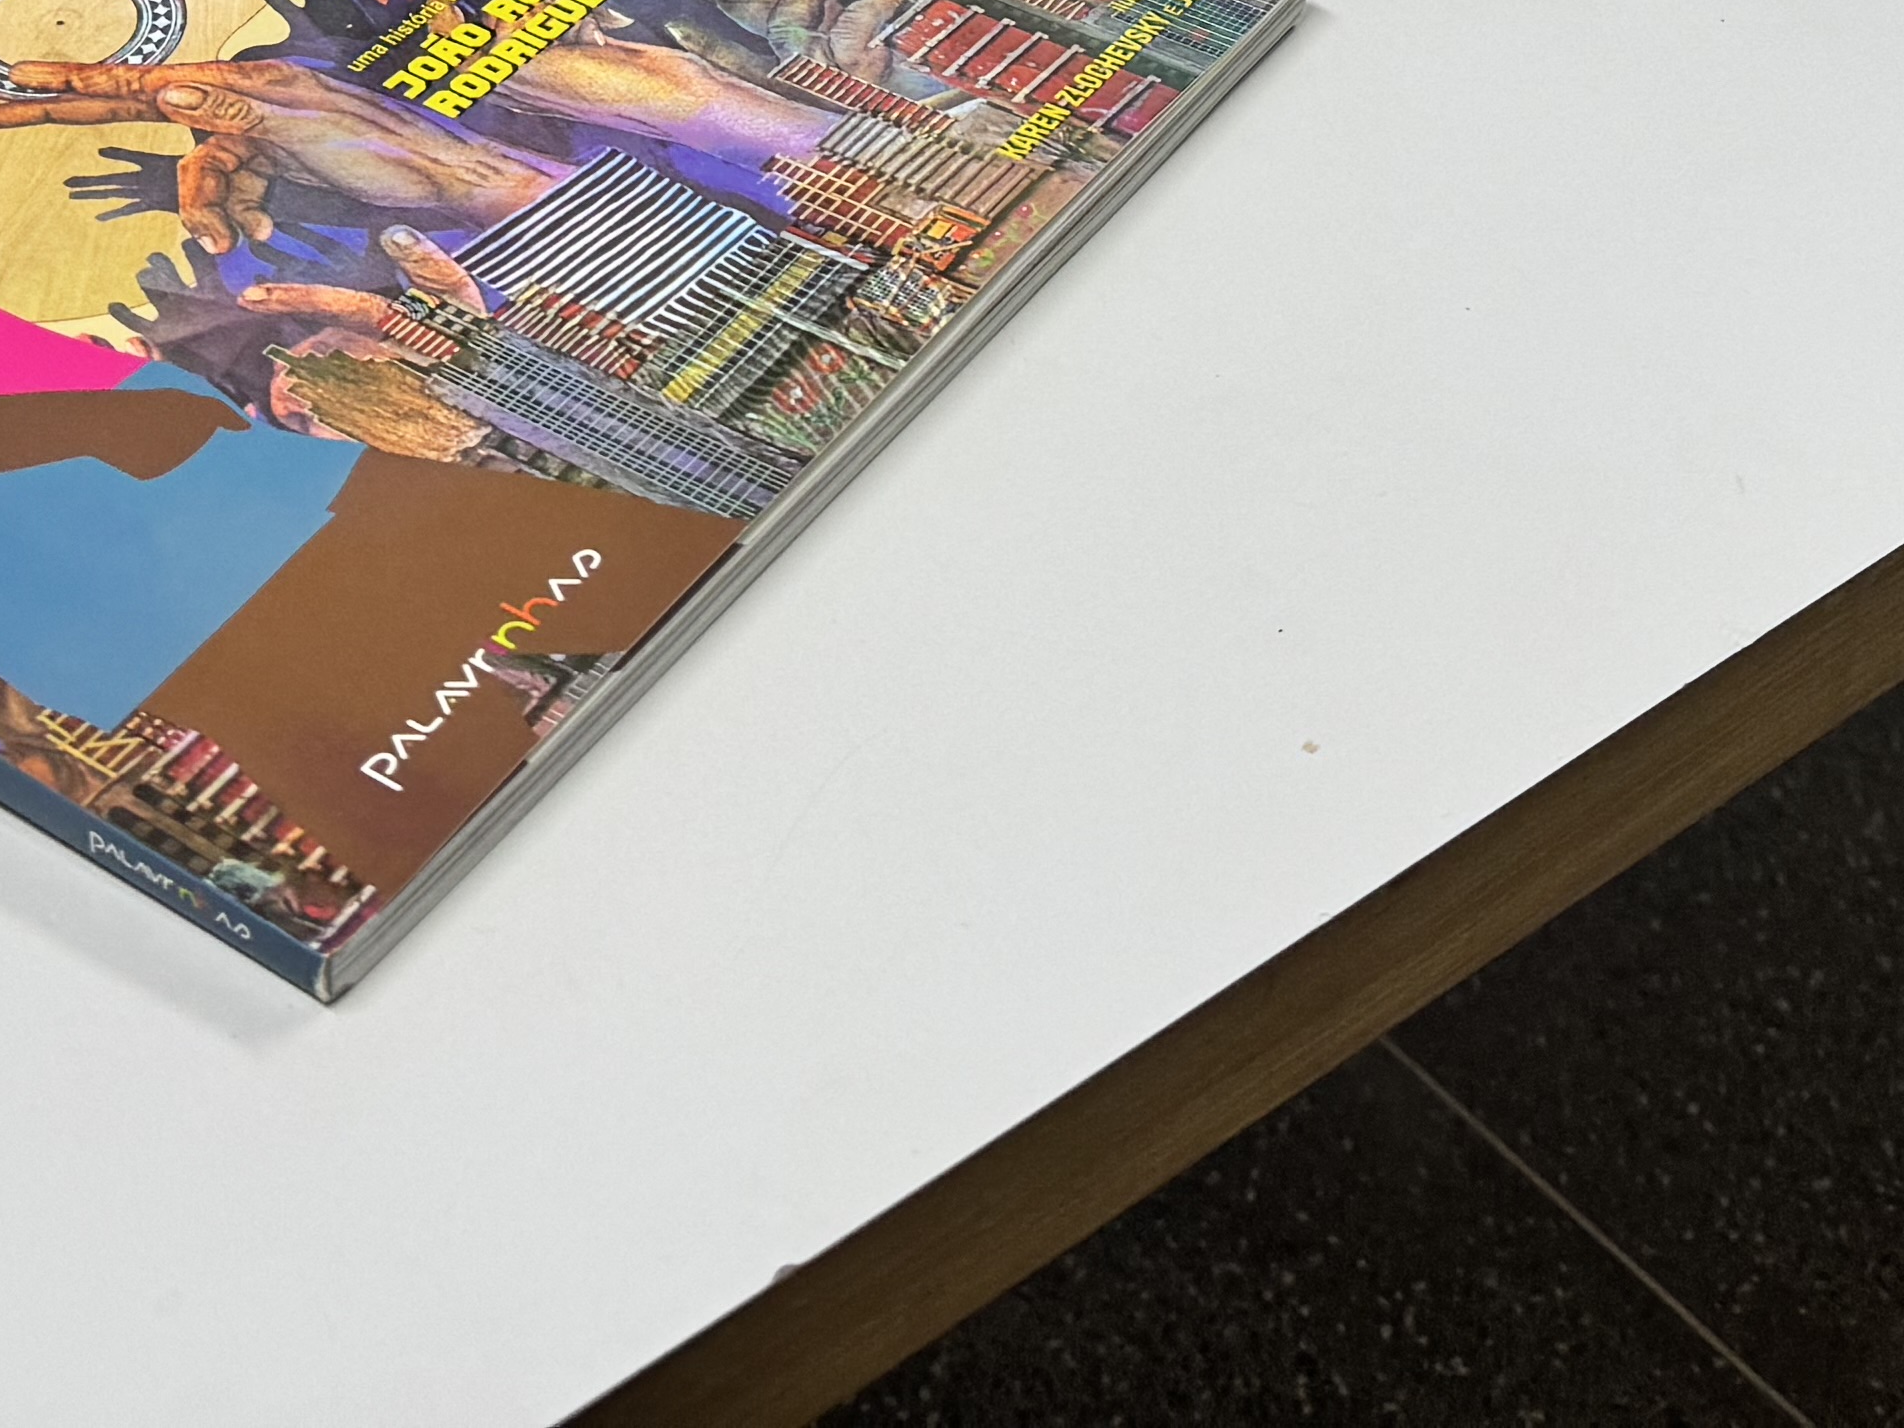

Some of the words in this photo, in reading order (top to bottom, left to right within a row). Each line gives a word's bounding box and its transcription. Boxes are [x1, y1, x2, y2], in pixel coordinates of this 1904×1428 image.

[347, 43, 387, 74] uma
[385, 0, 448, 48] história
[382, 21, 496, 100] JOÃO
[996, 101, 1072, 162] KAREN
[1055, 10, 1171, 108] ZLOCHEVSKY
